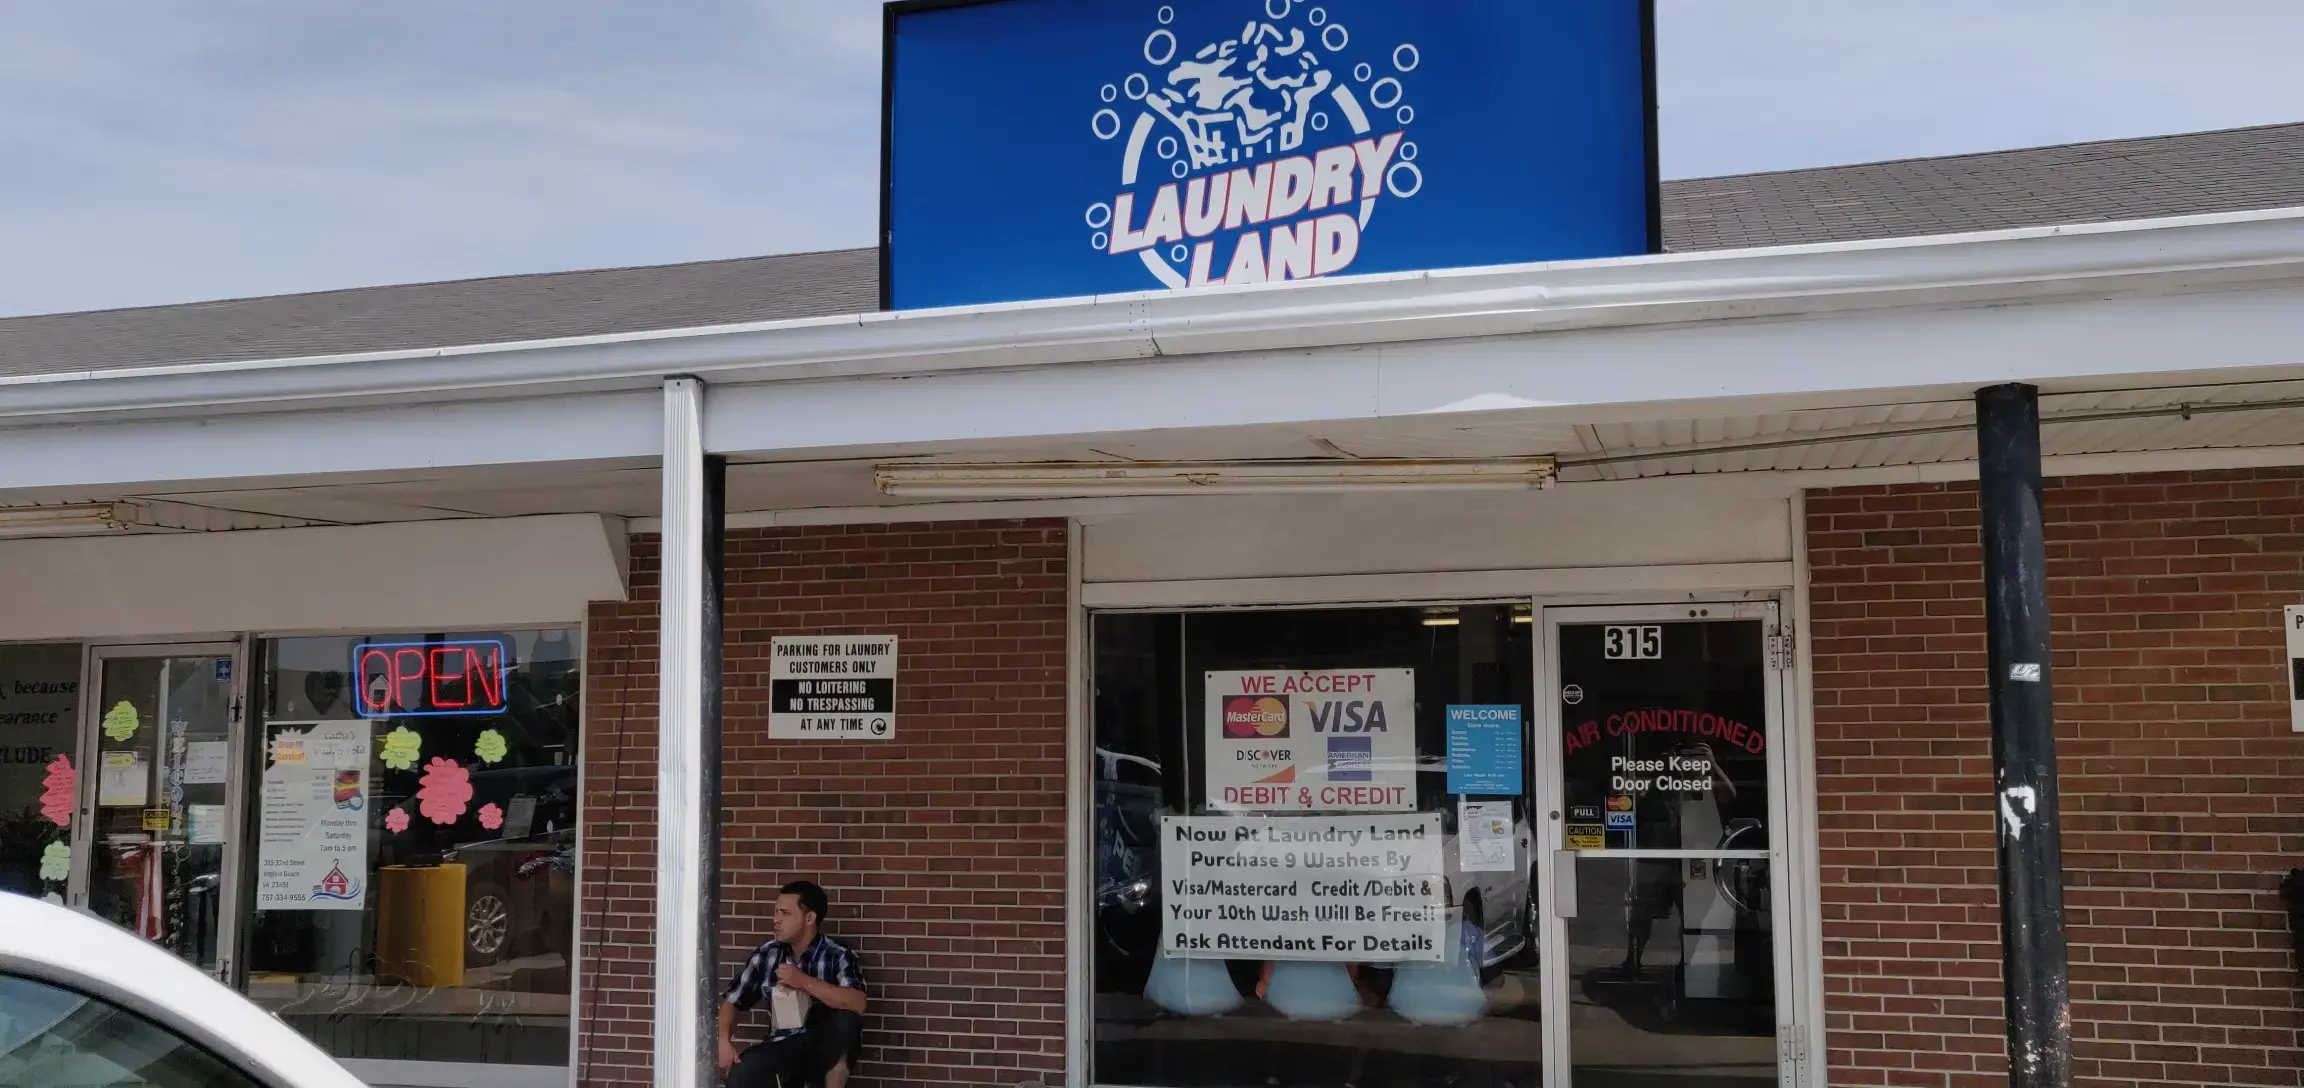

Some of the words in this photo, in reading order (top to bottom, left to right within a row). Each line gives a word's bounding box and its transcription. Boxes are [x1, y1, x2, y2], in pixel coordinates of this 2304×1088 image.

[1108, 130, 1404, 256] LAUNDRY
[1185, 212, 1360, 289] LAND
[777, 644, 819, 656] PARKING
[823, 644, 841, 656] FOR
[845, 643, 890, 656] LAUNDRY
[1606, 627, 1659, 658] 315
[789, 661, 848, 674] CUSTOMERS
[852, 661, 876, 673] ONLY
[360, 647, 499, 708] OPEN
[1241, 675, 1276, 694] WE
[1282, 674, 1376, 693] ACCEPT
[14, 680, 78, 694] because
[798, 681, 812, 694] NO
[815, 681, 866, 694] LOITERING
[789, 698, 803, 711] NO
[807, 697, 875, 711] TRESPASSING
[1226, 711, 1287, 723] MasterCard
[1302, 700, 1388, 732] VISA
[1451, 709, 1517, 720] WELCOME
[800, 718, 812, 731] AT
[816, 718, 836, 731] ANY
[840, 718, 864, 731] TIME
[1565, 719, 1601, 754] AIR
[1606, 709, 1764, 754] CONDITIONED
[1611, 756, 1664, 772] Please
[1669, 756, 1712, 775] Keep
[1612, 776, 1651, 791] Door
[1656, 775, 1712, 791] Closed
[1224, 786, 1291, 805] DEBIT
[1297, 786, 1313, 805] &
[1320, 786, 1406, 805] CREDIT
[1574, 808, 1595, 816] PULL
[1610, 815, 1633, 823] VISA
[321, 820, 344, 828] Monday
[1568, 826, 1602, 835] CAUTION
[325, 832, 352, 840] Saturday
[1175, 825, 1227, 843] Now
[1234, 825, 1261, 843] At
[1268, 826, 1363, 846] Laundry
[1370, 824, 1425, 841] Land
[347, 845, 357, 853] pm
[1191, 851, 1279, 868] Purchase
[1284, 852, 1297, 868] 9
[1303, 851, 1380, 868] Washes
[1386, 850, 1411, 872] By
[1172, 879, 1297, 897] Visa/Mastercard
[1311, 879, 1360, 897] Credit
[1363, 879, 1415, 897] /Debit
[1420, 880, 1432, 897] &
[1170, 904, 1212, 921] Your
[1217, 904, 1256, 921] 10th
[1261, 905, 1309, 922] Wash
[1315, 905, 1349, 922] Will
[1355, 905, 1376, 922] Be
[1381, 905, 1436, 922] Free!!
[1175, 933, 1211, 949] Ask
[1217, 933, 1316, 951] Attendant
[1321, 935, 1357, 952] For
[1363, 935, 1433, 952] Details
